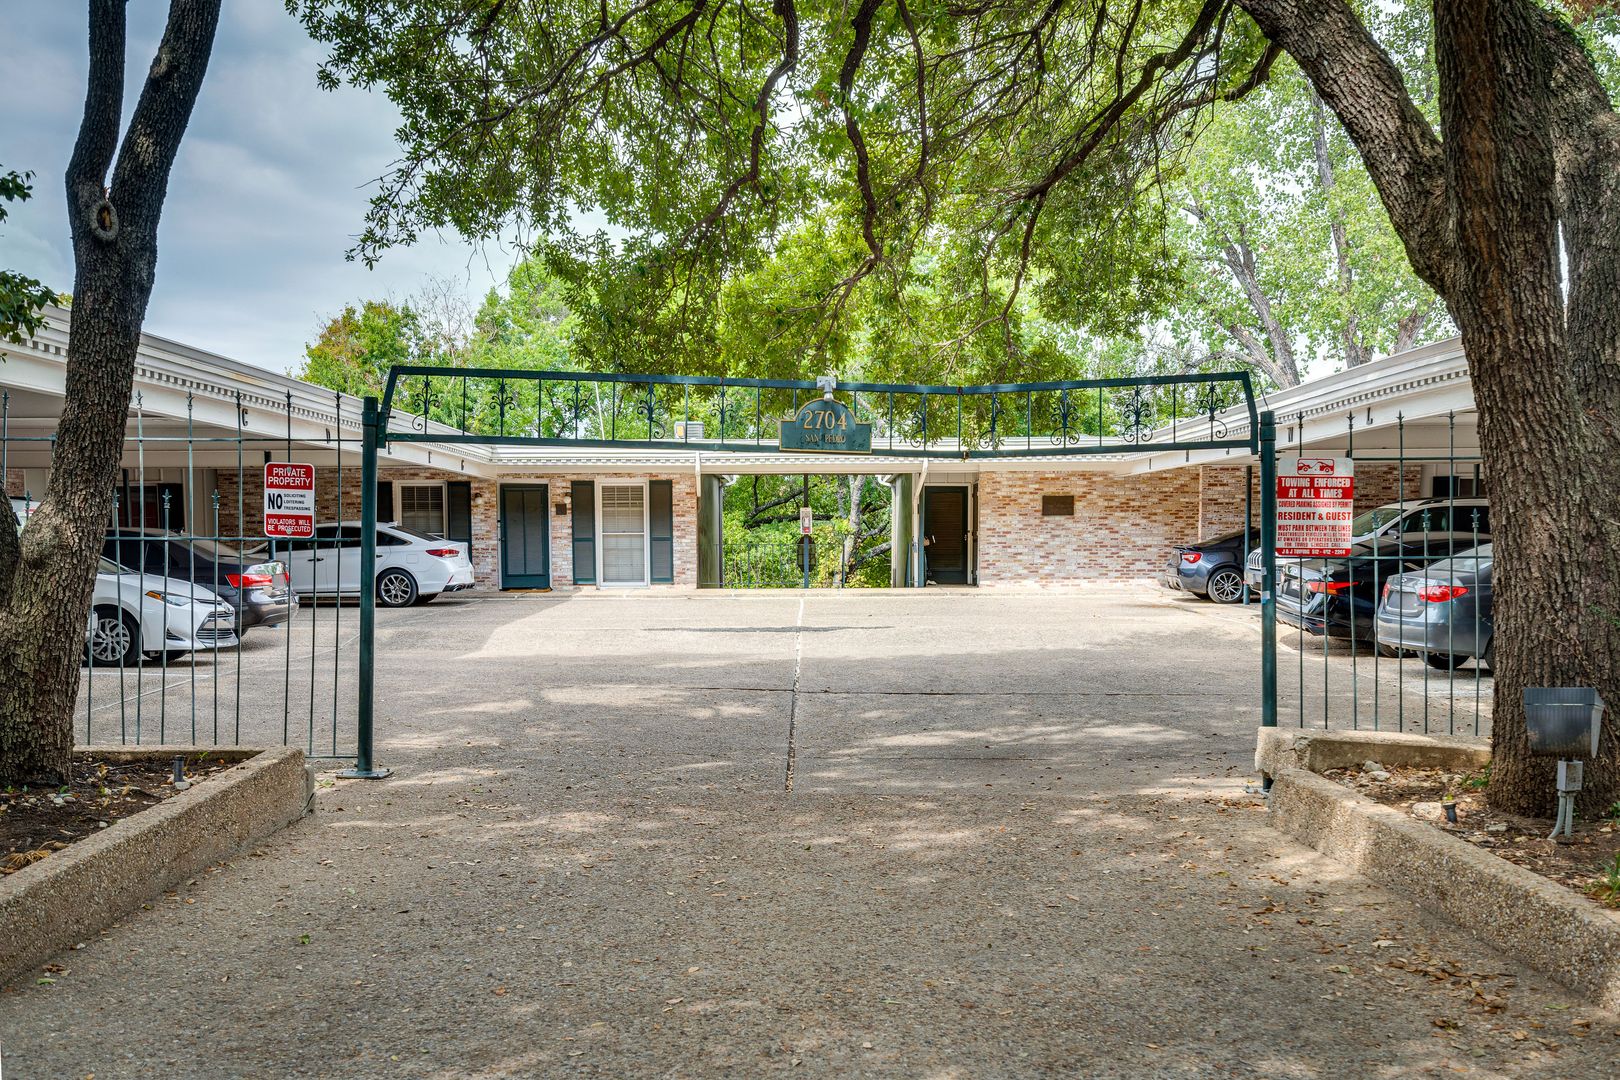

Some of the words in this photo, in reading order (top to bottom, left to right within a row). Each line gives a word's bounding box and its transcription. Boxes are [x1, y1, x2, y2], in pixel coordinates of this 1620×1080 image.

[241, 408, 248, 426] C
[804, 411, 847, 430] 2704
[805, 434, 819, 442] SAN
[825, 434, 846, 443] PEDRO
[273, 468, 306, 477] PRIVATE
[268, 477, 311, 486] PROPERTY
[1281, 478, 1310, 487] TOWING
[1314, 478, 1350, 488] ENFORCED
[1288, 489, 1297, 497] AT
[1302, 489, 1315, 497] ALL
[1320, 489, 1342, 498] TIMES
[268, 493, 283, 509] NO
[1278, 512, 1316, 520] RESIDENT
[1317, 512, 1323, 521] &
[1325, 512, 1351, 521] GUEST
